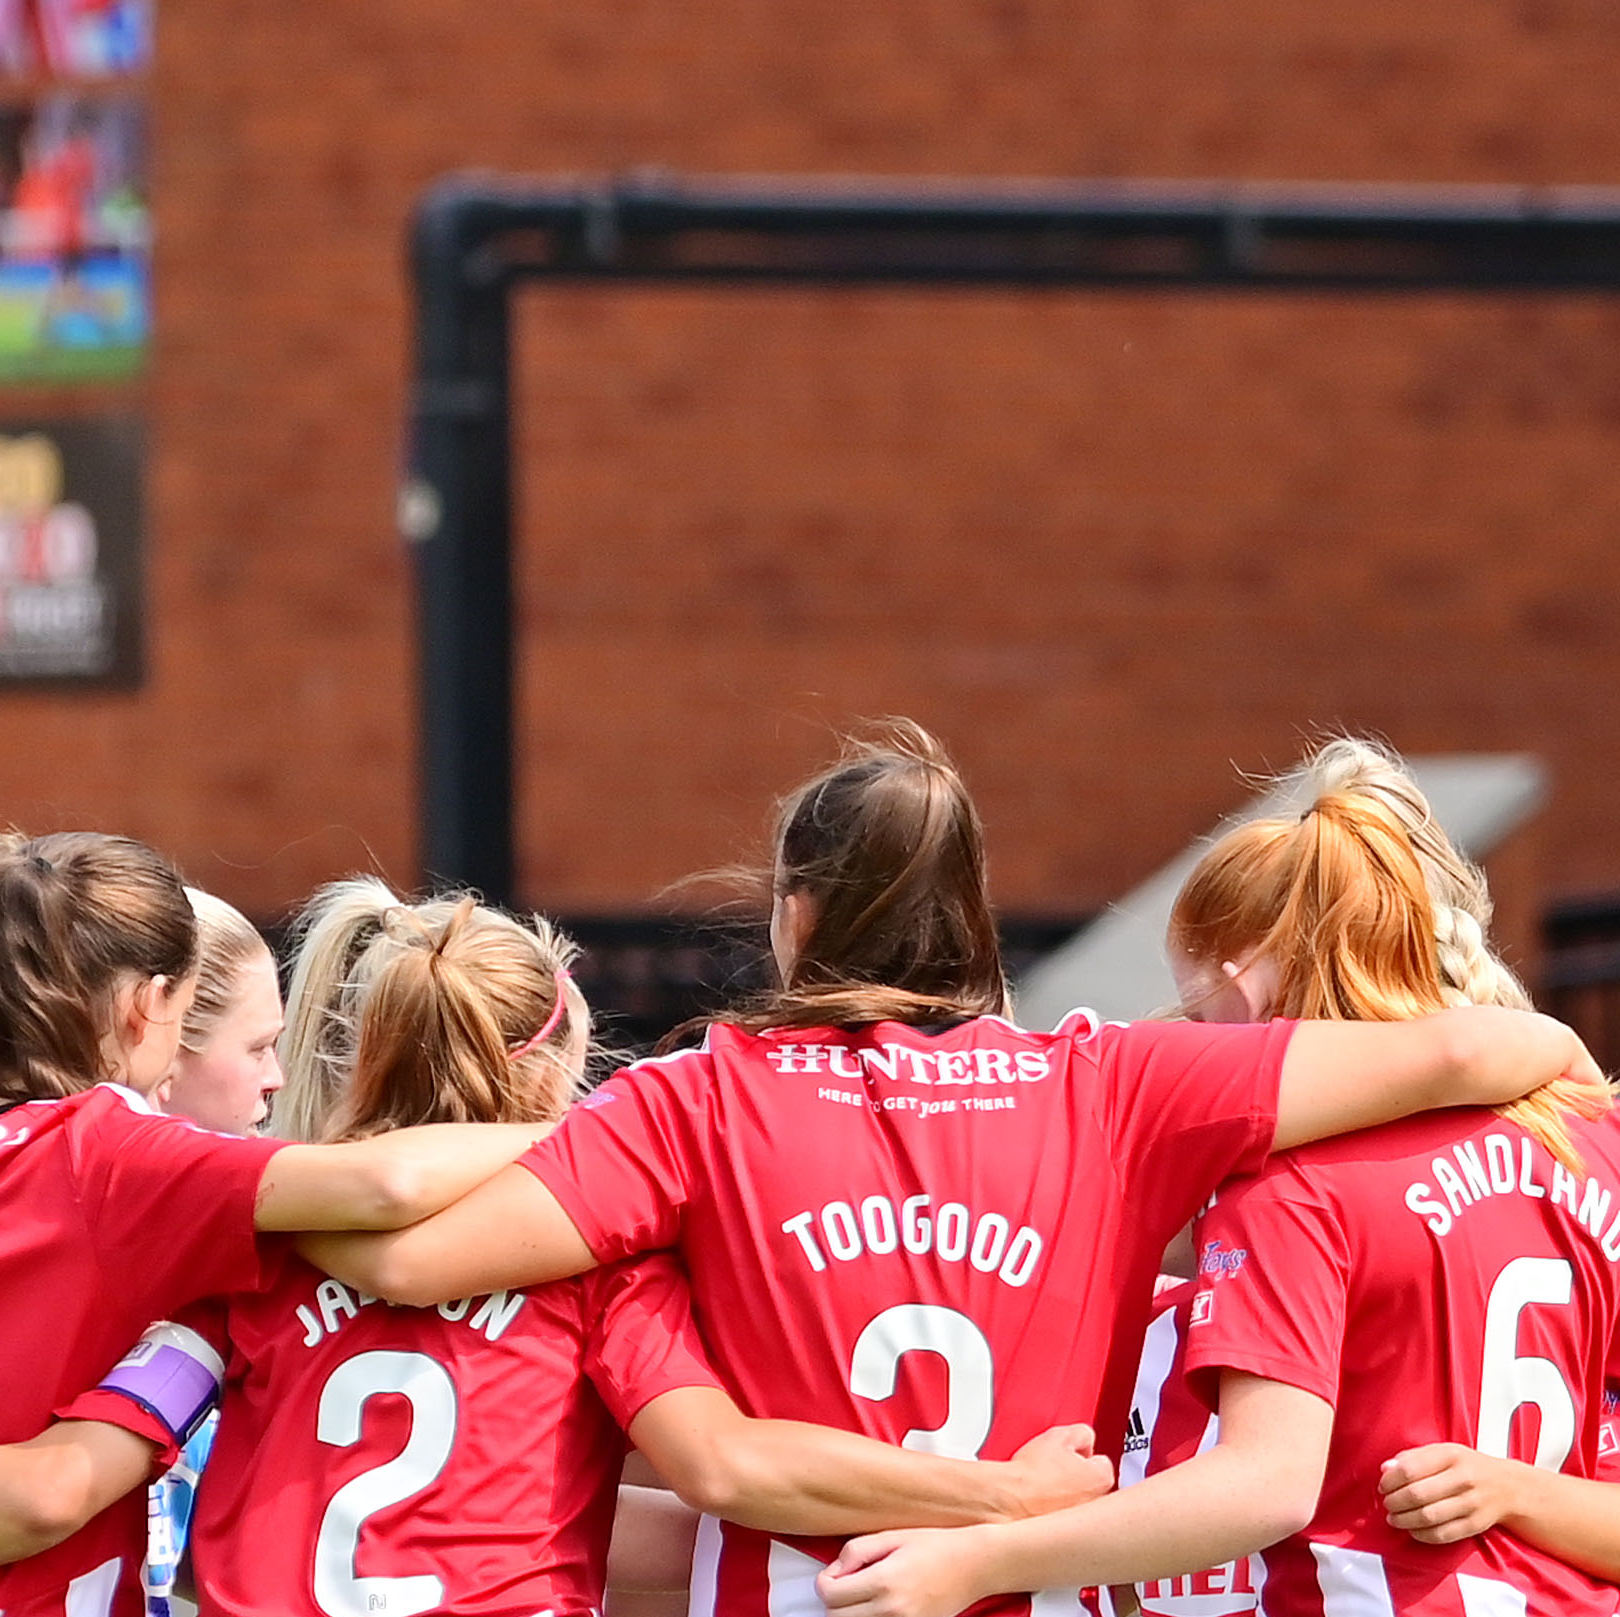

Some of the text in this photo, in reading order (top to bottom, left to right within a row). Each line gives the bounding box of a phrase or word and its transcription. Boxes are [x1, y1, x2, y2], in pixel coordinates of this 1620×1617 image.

[767, 1043, 1054, 1085] HUNTERS
[818, 1088, 862, 1106] HERE
[883, 1097, 918, 1111] GET
[918, 1099, 957, 1118] you
[961, 1097, 1016, 1110] THERE
[781, 1194, 1043, 1287] TOOGOOD
[1476, 1256, 1575, 1475] 6
